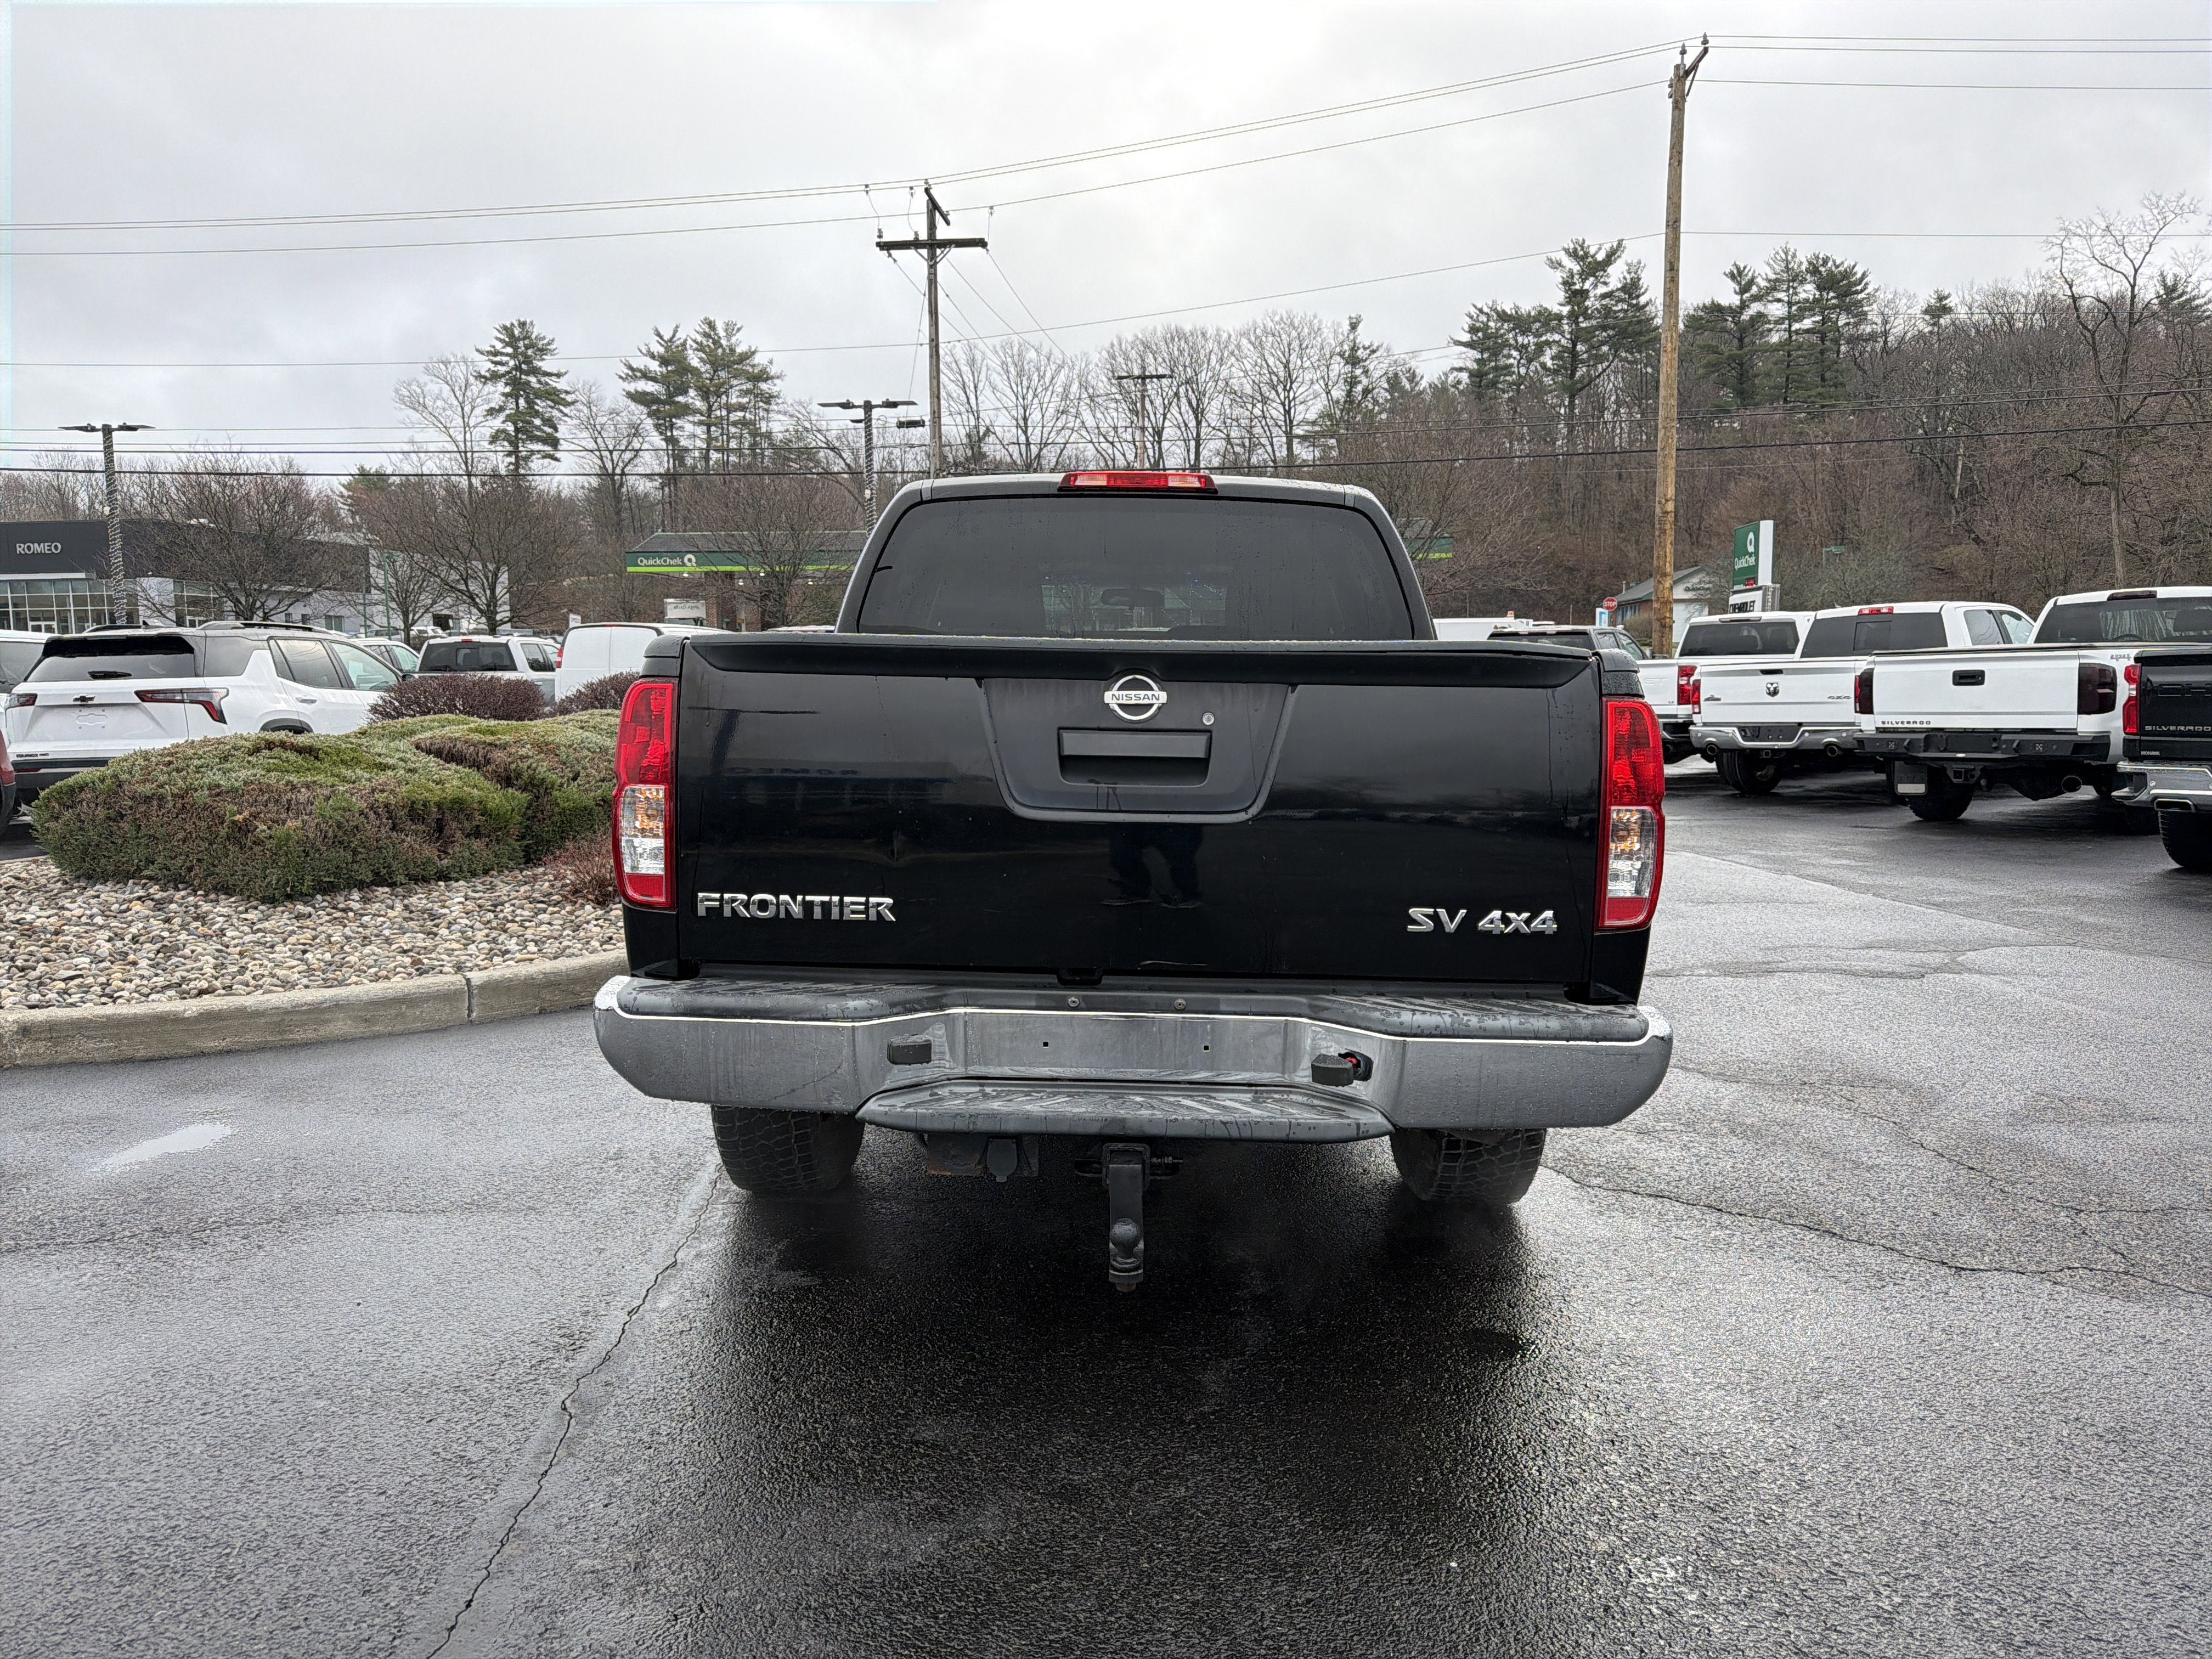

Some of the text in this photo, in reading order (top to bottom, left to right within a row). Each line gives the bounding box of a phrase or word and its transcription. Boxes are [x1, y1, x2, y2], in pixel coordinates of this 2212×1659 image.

[16, 542, 61, 554] ROMEO
[637, 557, 682, 566] QuickChek
[1734, 555, 1756, 571] QuickChek
[698, 893, 896, 922] FRONTIER
[1407, 908, 1467, 933] SV
